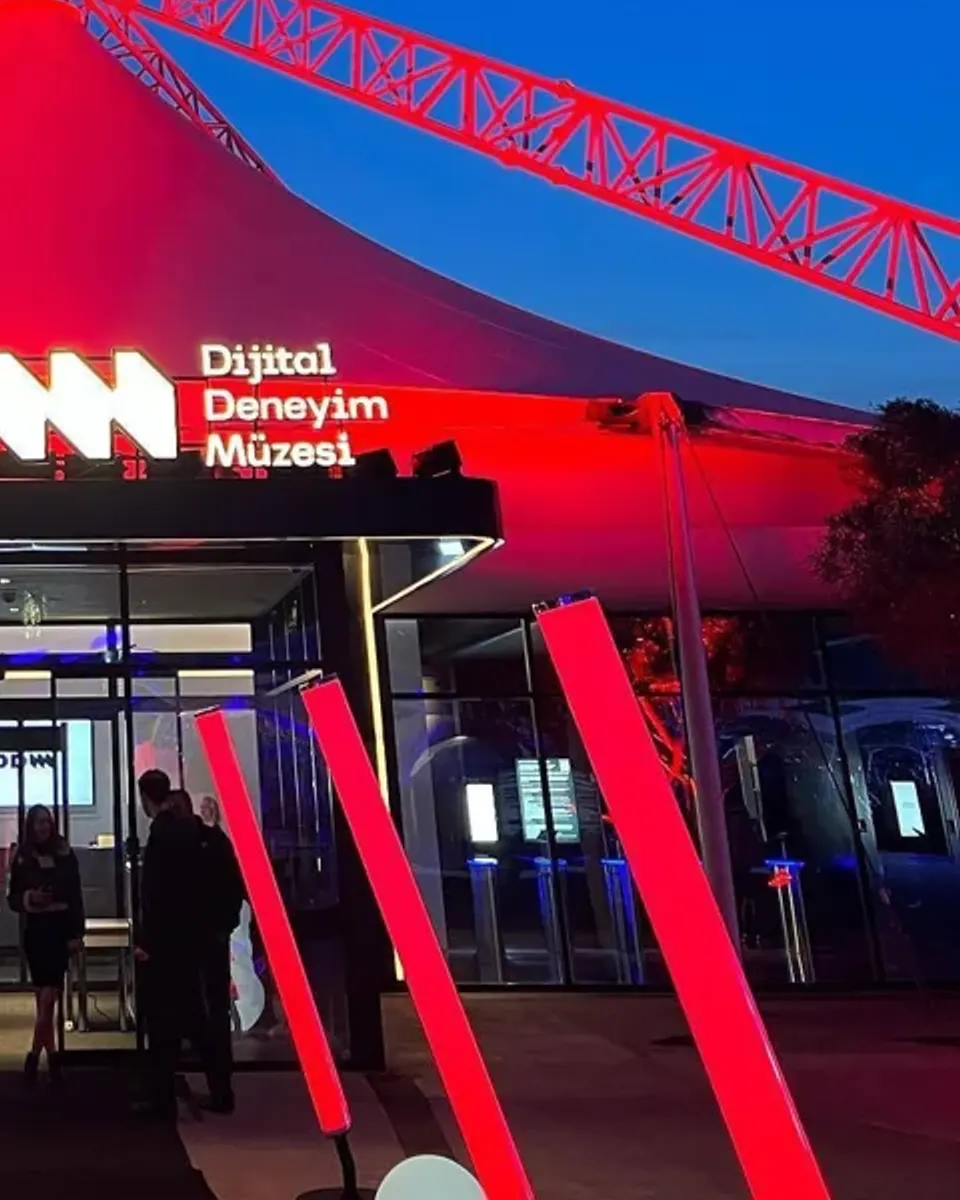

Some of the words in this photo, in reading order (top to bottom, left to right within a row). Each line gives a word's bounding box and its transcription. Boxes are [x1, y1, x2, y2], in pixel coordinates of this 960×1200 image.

[201, 343, 337, 385] Dijital
[204, 388, 389, 430] Deneyim
[205, 432, 356, 468] Müzesi
